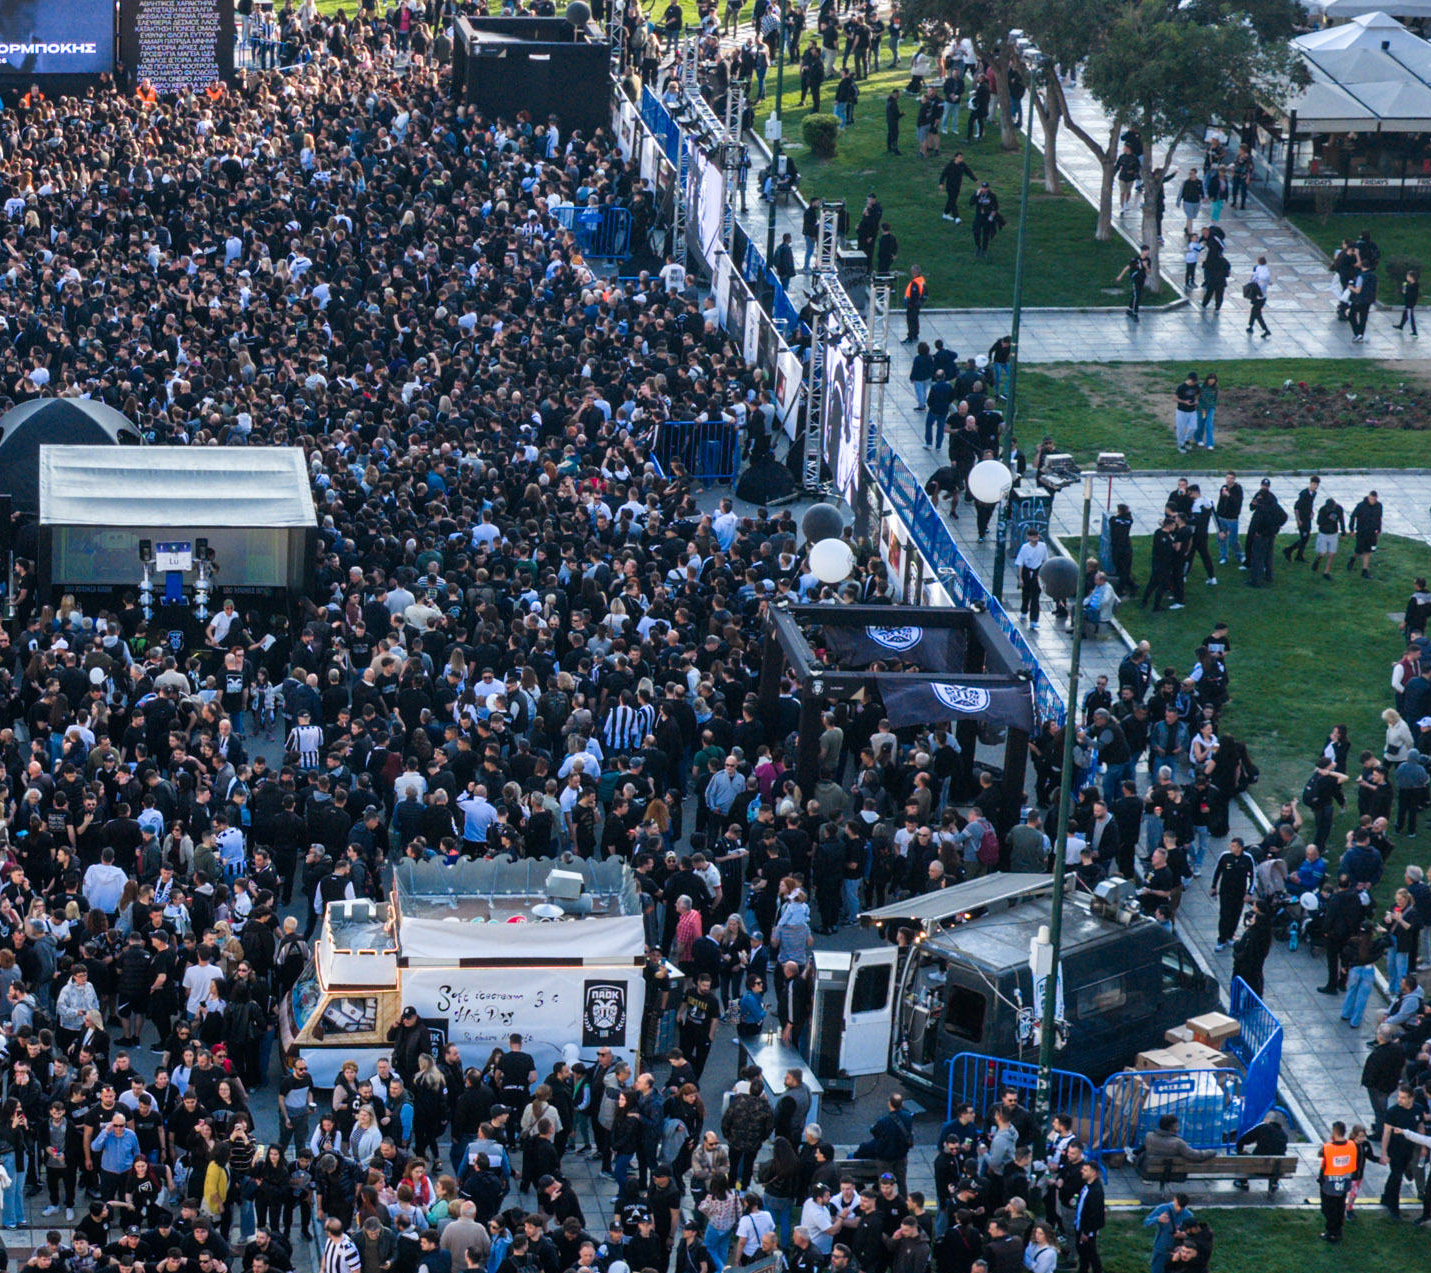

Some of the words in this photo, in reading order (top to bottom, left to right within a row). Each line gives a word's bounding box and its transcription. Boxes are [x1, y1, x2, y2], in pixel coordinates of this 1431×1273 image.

[438, 985, 469, 1011] Soft
[534, 991, 544, 1007] 3
[591, 991, 619, 1000] ΠΑΟΚ
